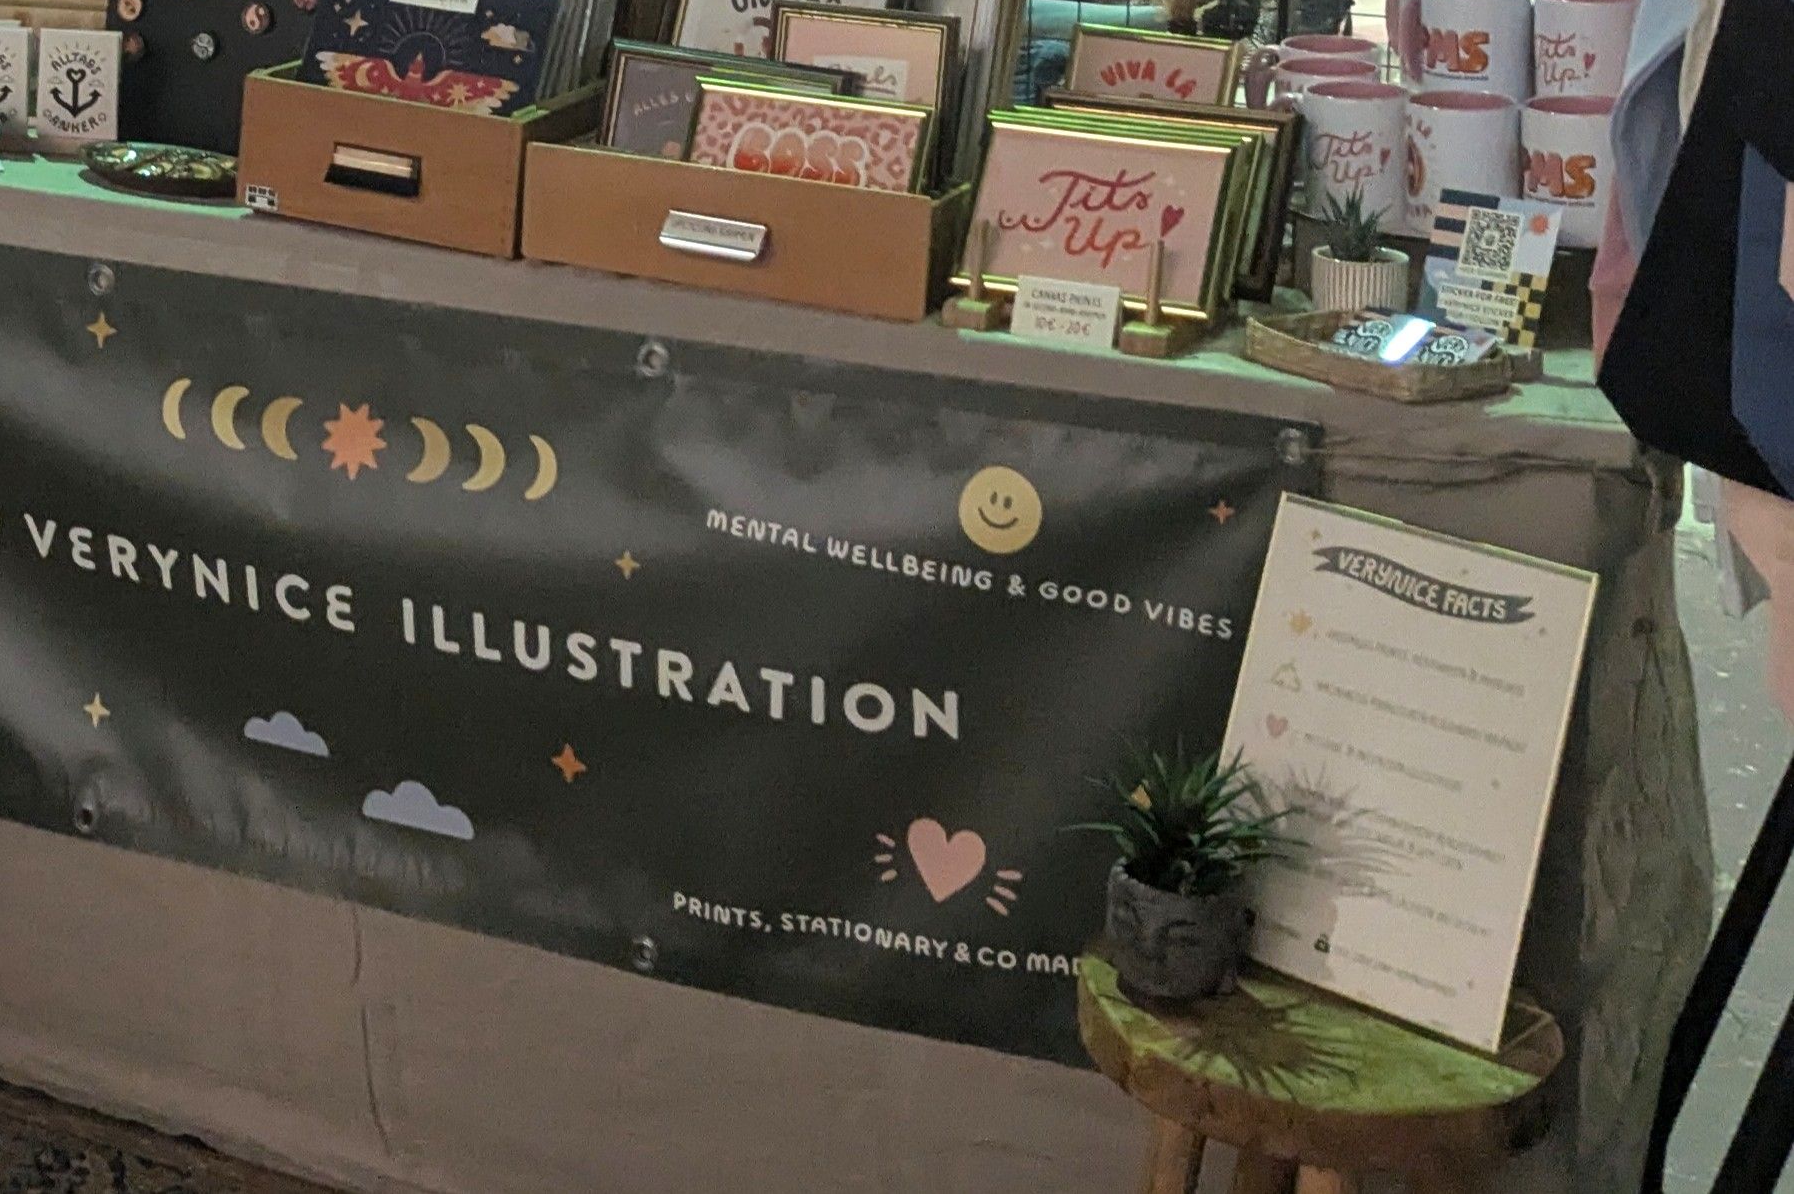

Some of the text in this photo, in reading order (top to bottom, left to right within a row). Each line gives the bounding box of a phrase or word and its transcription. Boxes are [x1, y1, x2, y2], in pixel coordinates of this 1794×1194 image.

[51, 51, 102, 75] ALLTAGS
[1100, 58, 1156, 87] VIVA
[48, 115, 100, 134] ANKER
[1311, 131, 1373, 170] Tits
[999, 169, 1157, 232] Tits
[1064, 215, 1146, 269] Up
[706, 508, 1234, 640] MENTAL WELLBEING & GOOD VIBES
[1337, 551, 1506, 620] VERYNICE FACTS
[24, 512, 961, 741] VERYNICE ILLUSTRATION
[672, 891, 773, 934] PRINTS,
[780, 911, 949, 960] STATIONARY
[954, 941, 970, 964] &
[977, 946, 1017, 969] CO
